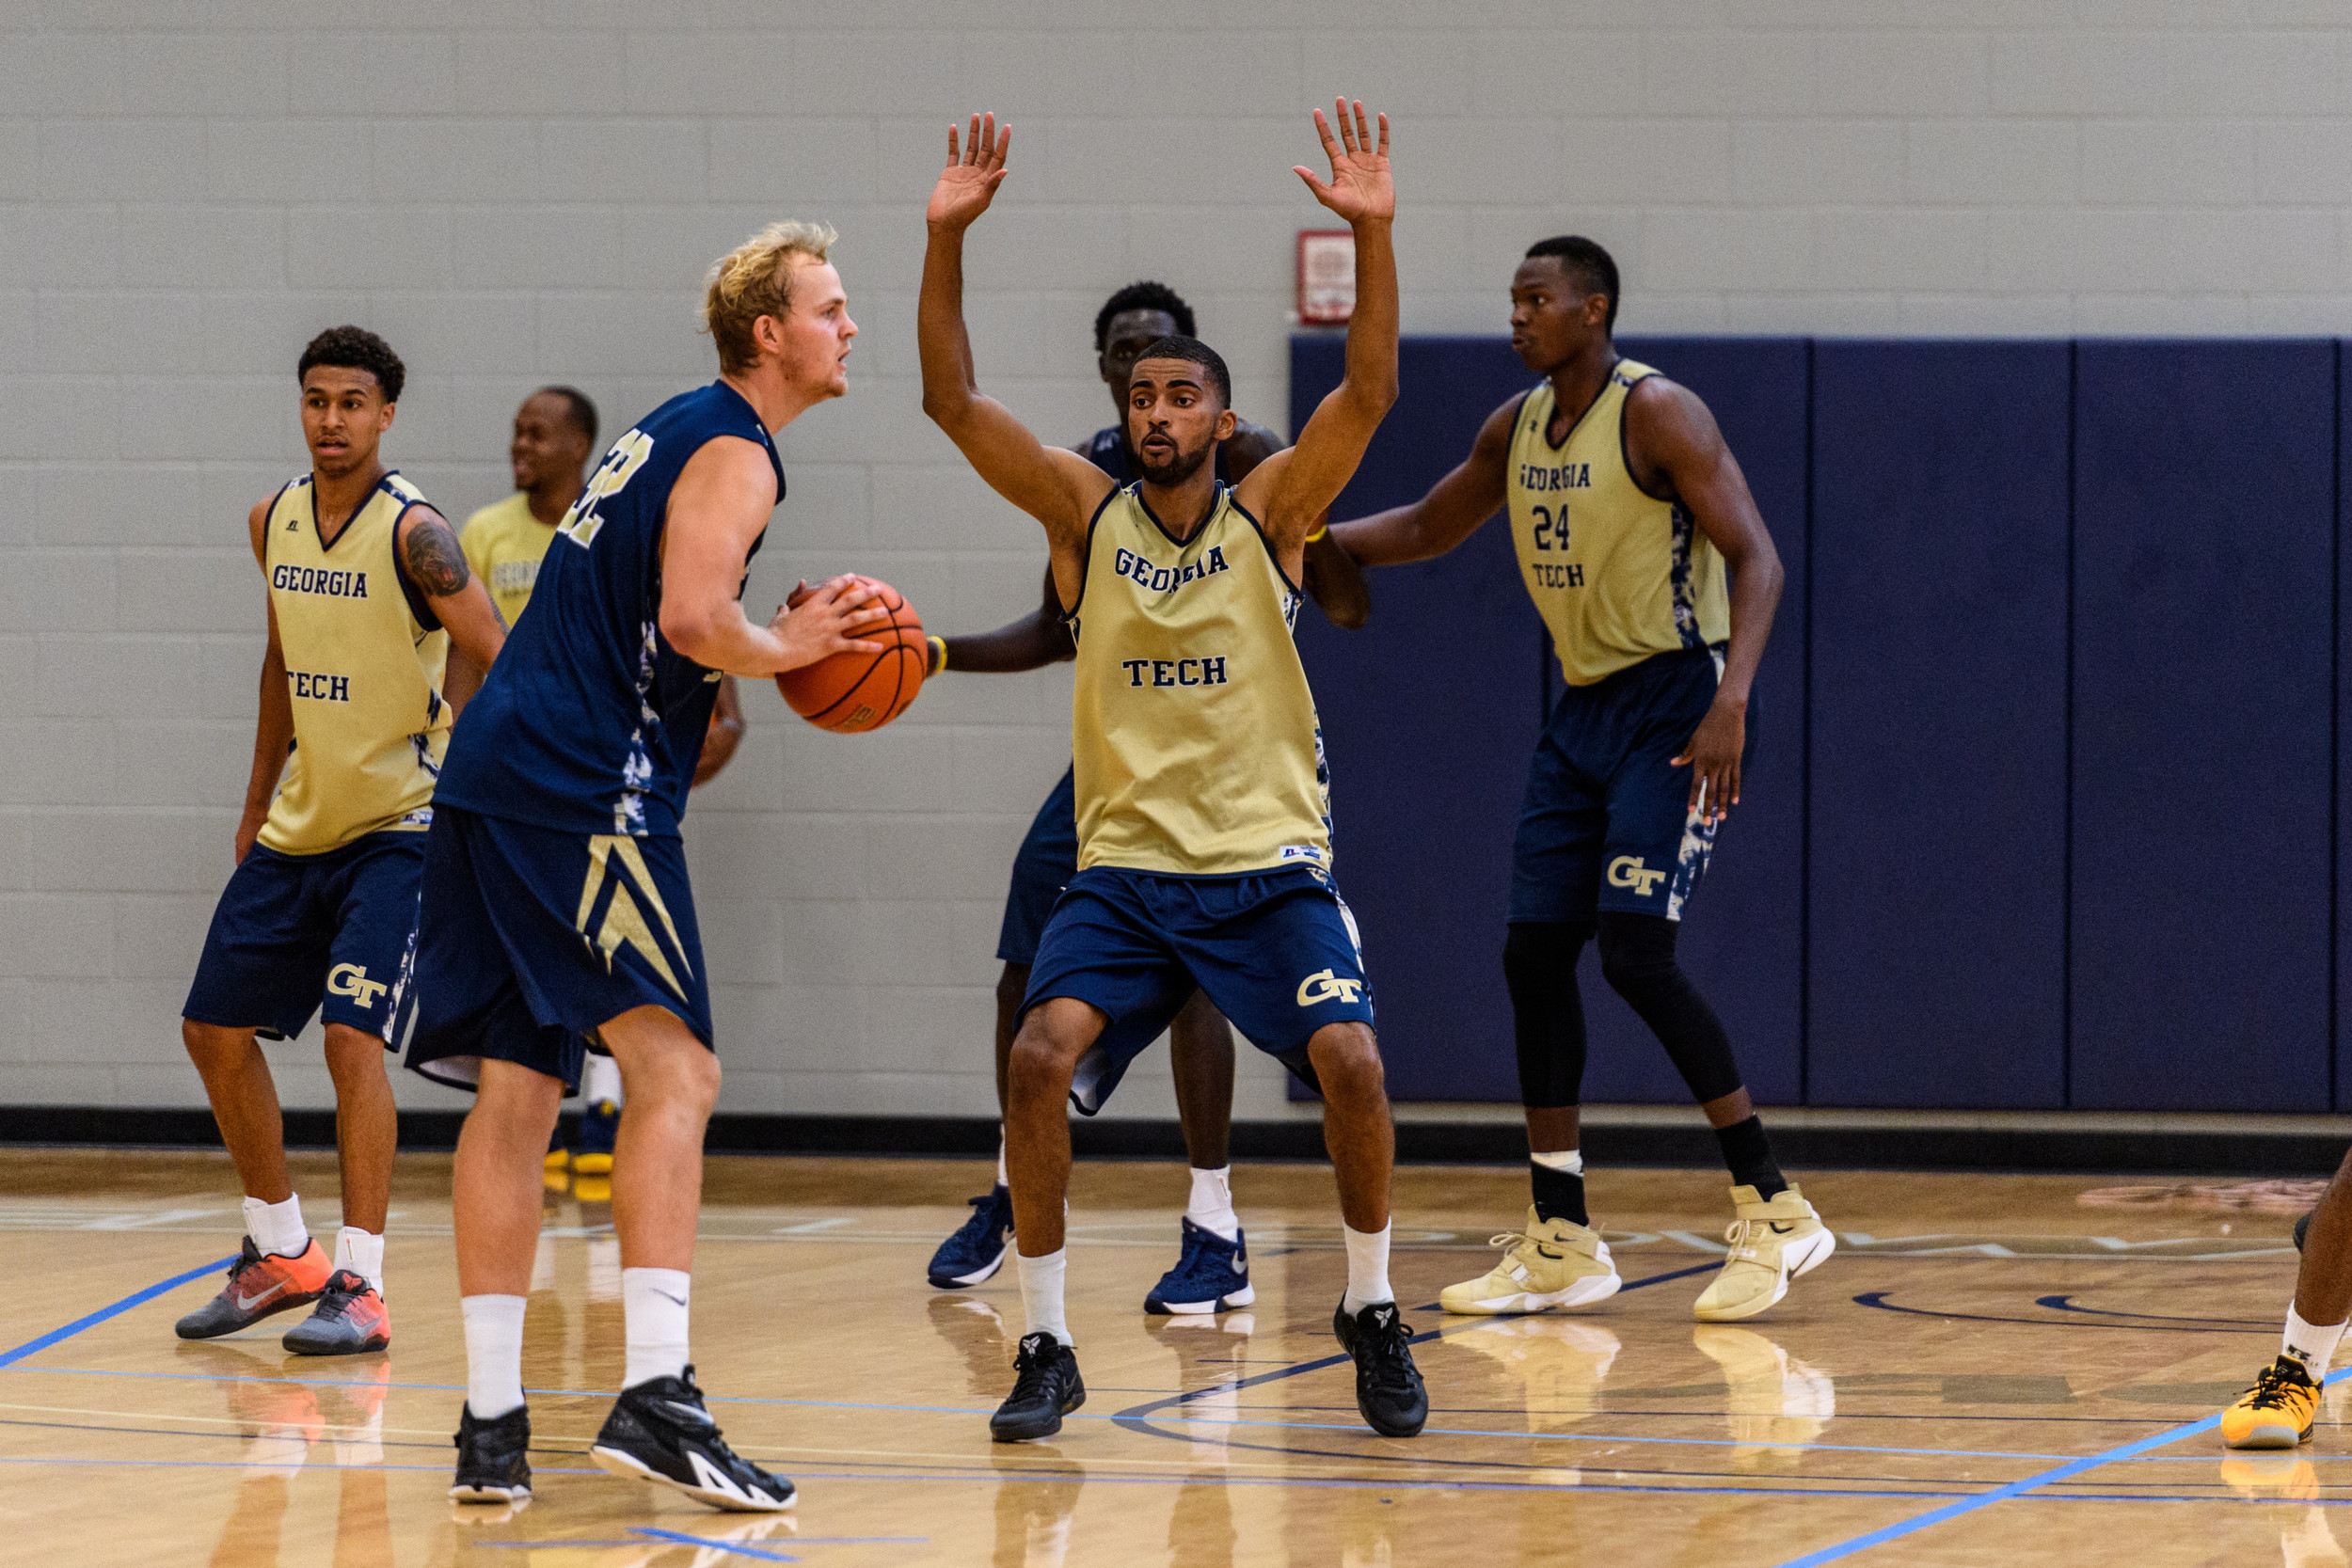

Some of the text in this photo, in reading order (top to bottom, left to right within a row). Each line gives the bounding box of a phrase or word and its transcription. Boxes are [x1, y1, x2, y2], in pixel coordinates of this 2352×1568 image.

[556, 427, 655, 549] 32
[1532, 502, 1570, 551] 24
[273, 564, 368, 598] GEORGIA
[1115, 545, 1230, 594] GEORGIA
[1532, 563, 1584, 589] TECH
[1121, 656, 1229, 688] TECH
